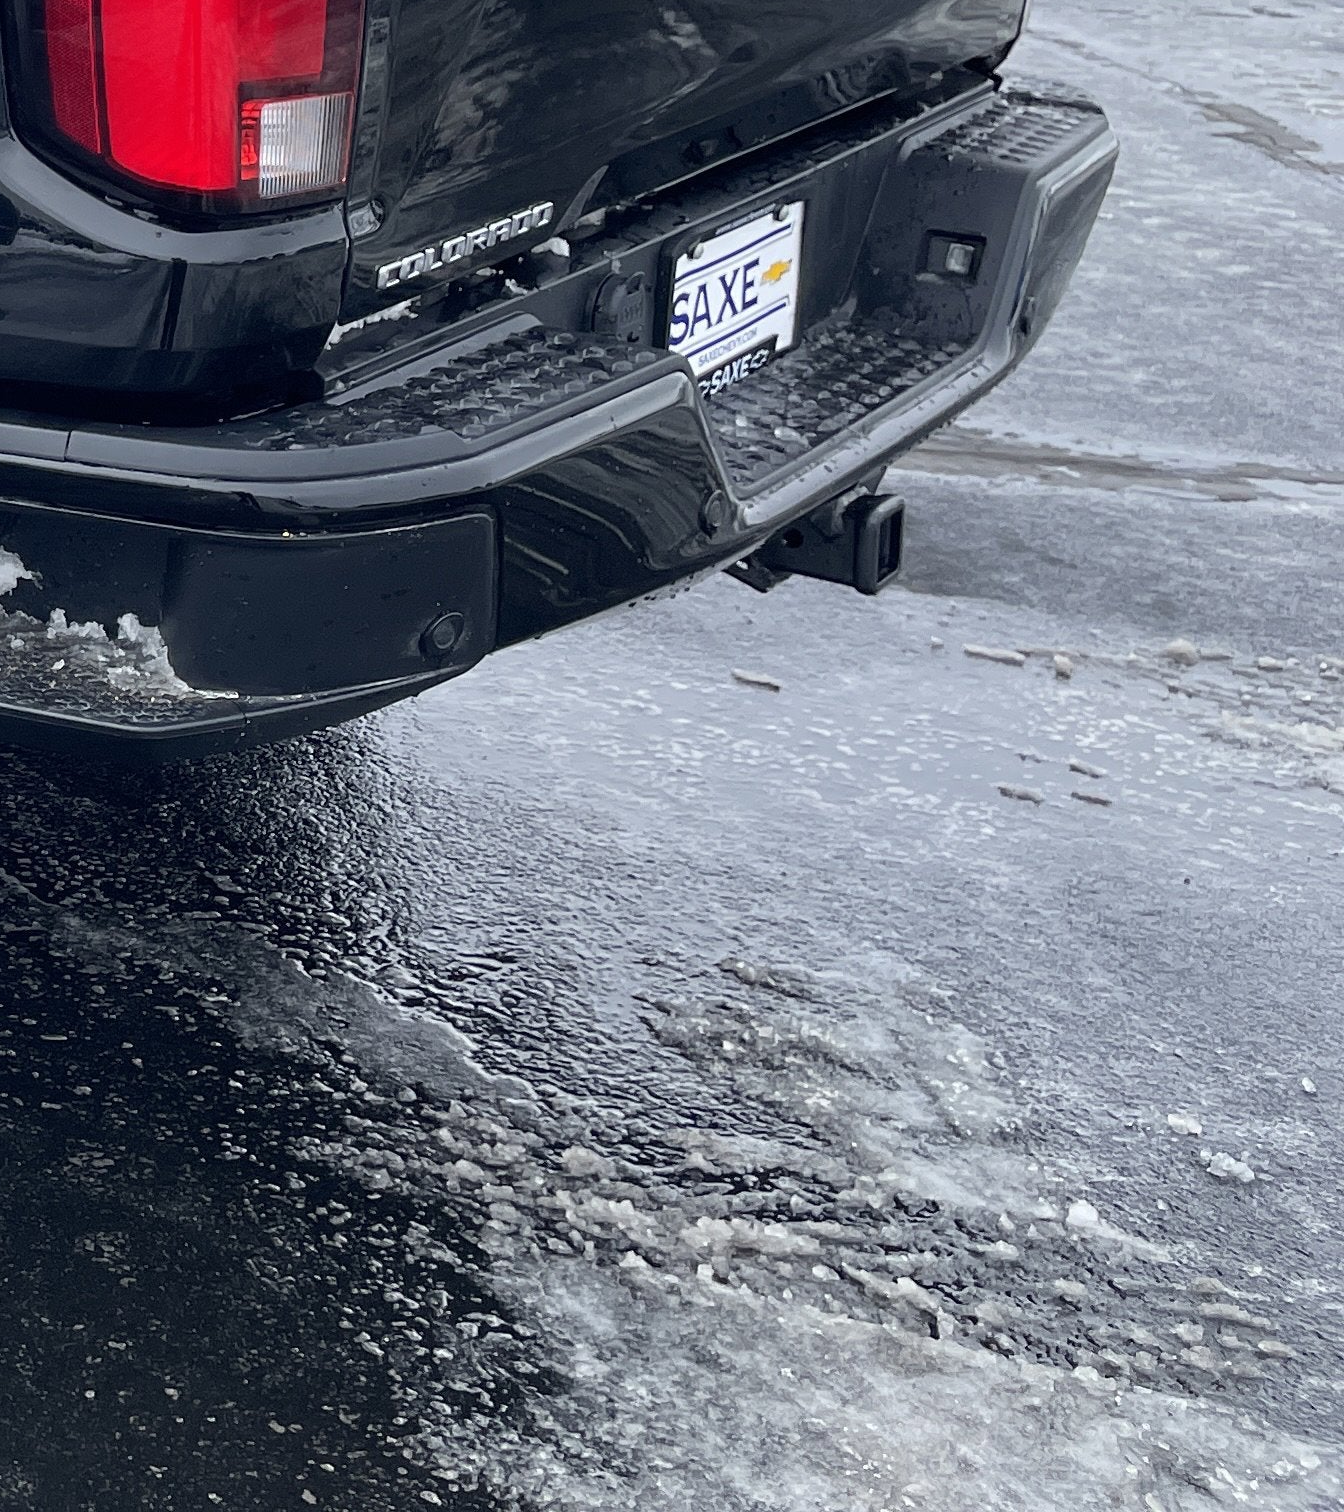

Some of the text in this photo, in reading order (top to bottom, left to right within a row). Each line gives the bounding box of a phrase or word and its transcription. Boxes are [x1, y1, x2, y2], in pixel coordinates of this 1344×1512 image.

[376, 200, 555, 289] COLORADO
[668, 258, 759, 346] SAXE
[709, 352, 752, 396] SAXE
